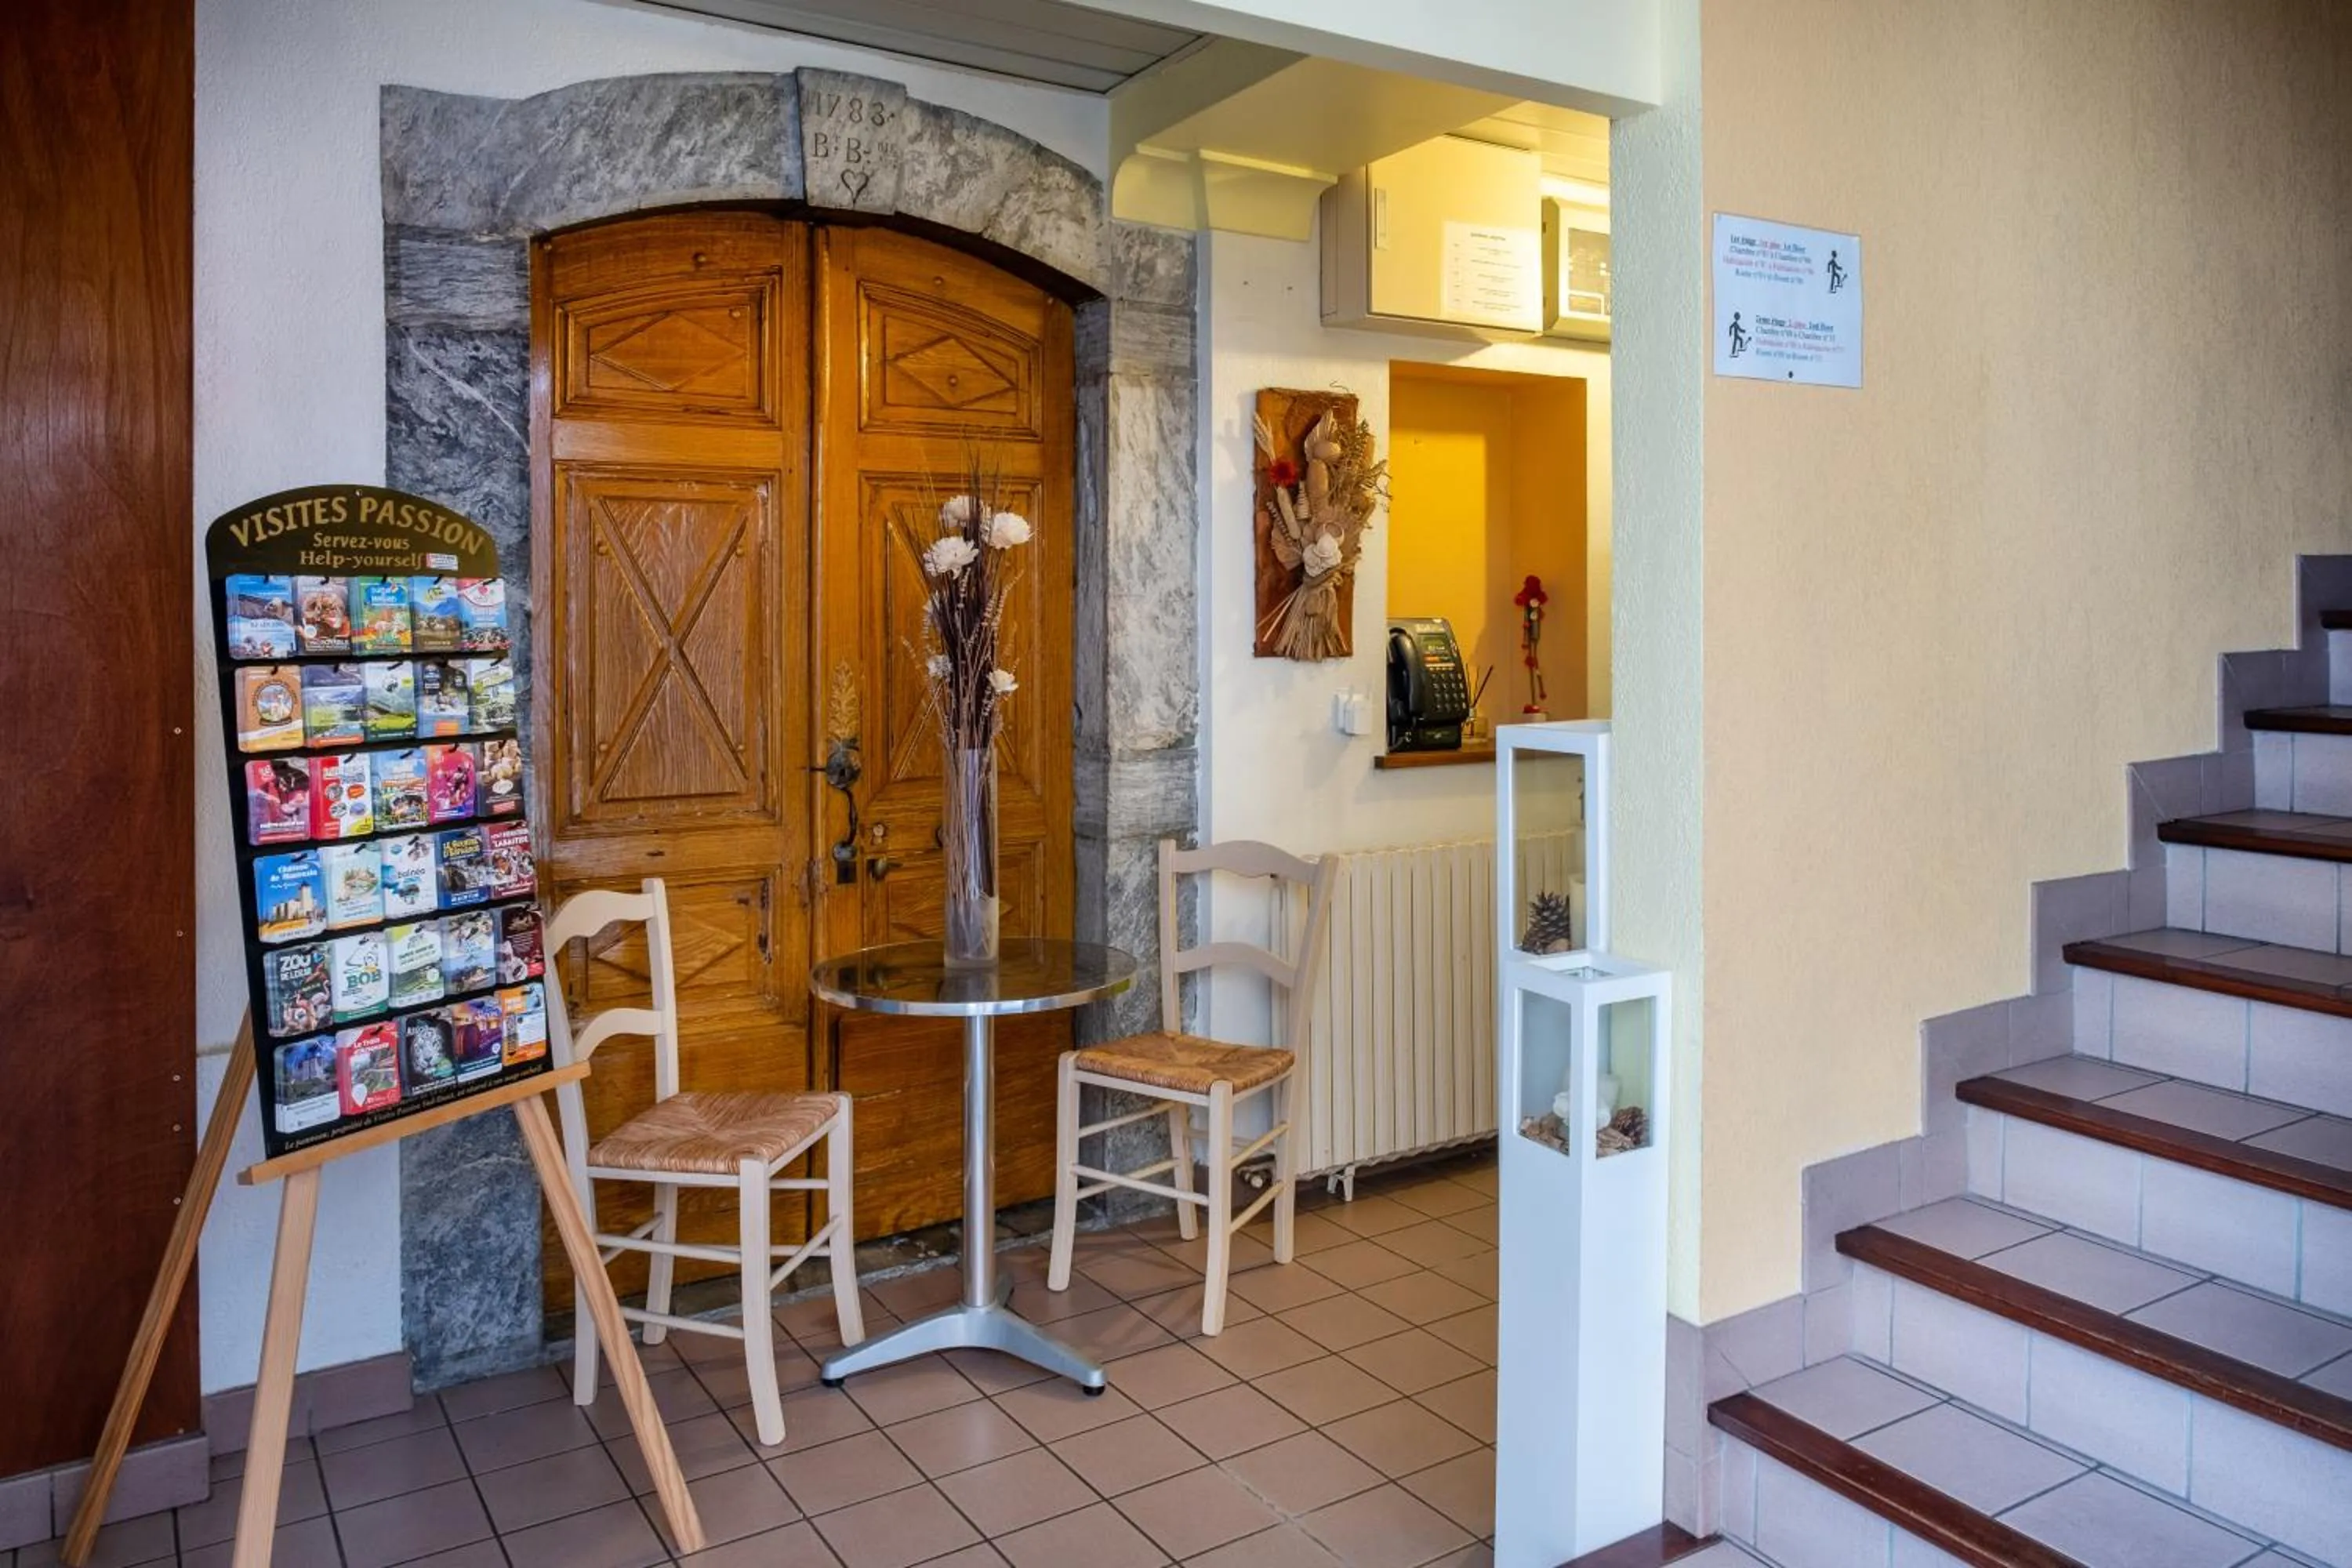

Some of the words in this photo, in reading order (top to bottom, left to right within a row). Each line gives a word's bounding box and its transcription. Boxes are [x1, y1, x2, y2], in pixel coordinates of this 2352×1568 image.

[230, 496, 348, 548] VISITES
[359, 496, 485, 555] PASSION
[313, 532, 410, 550] Servez-vous
[299, 550, 425, 569] Help-yourself
